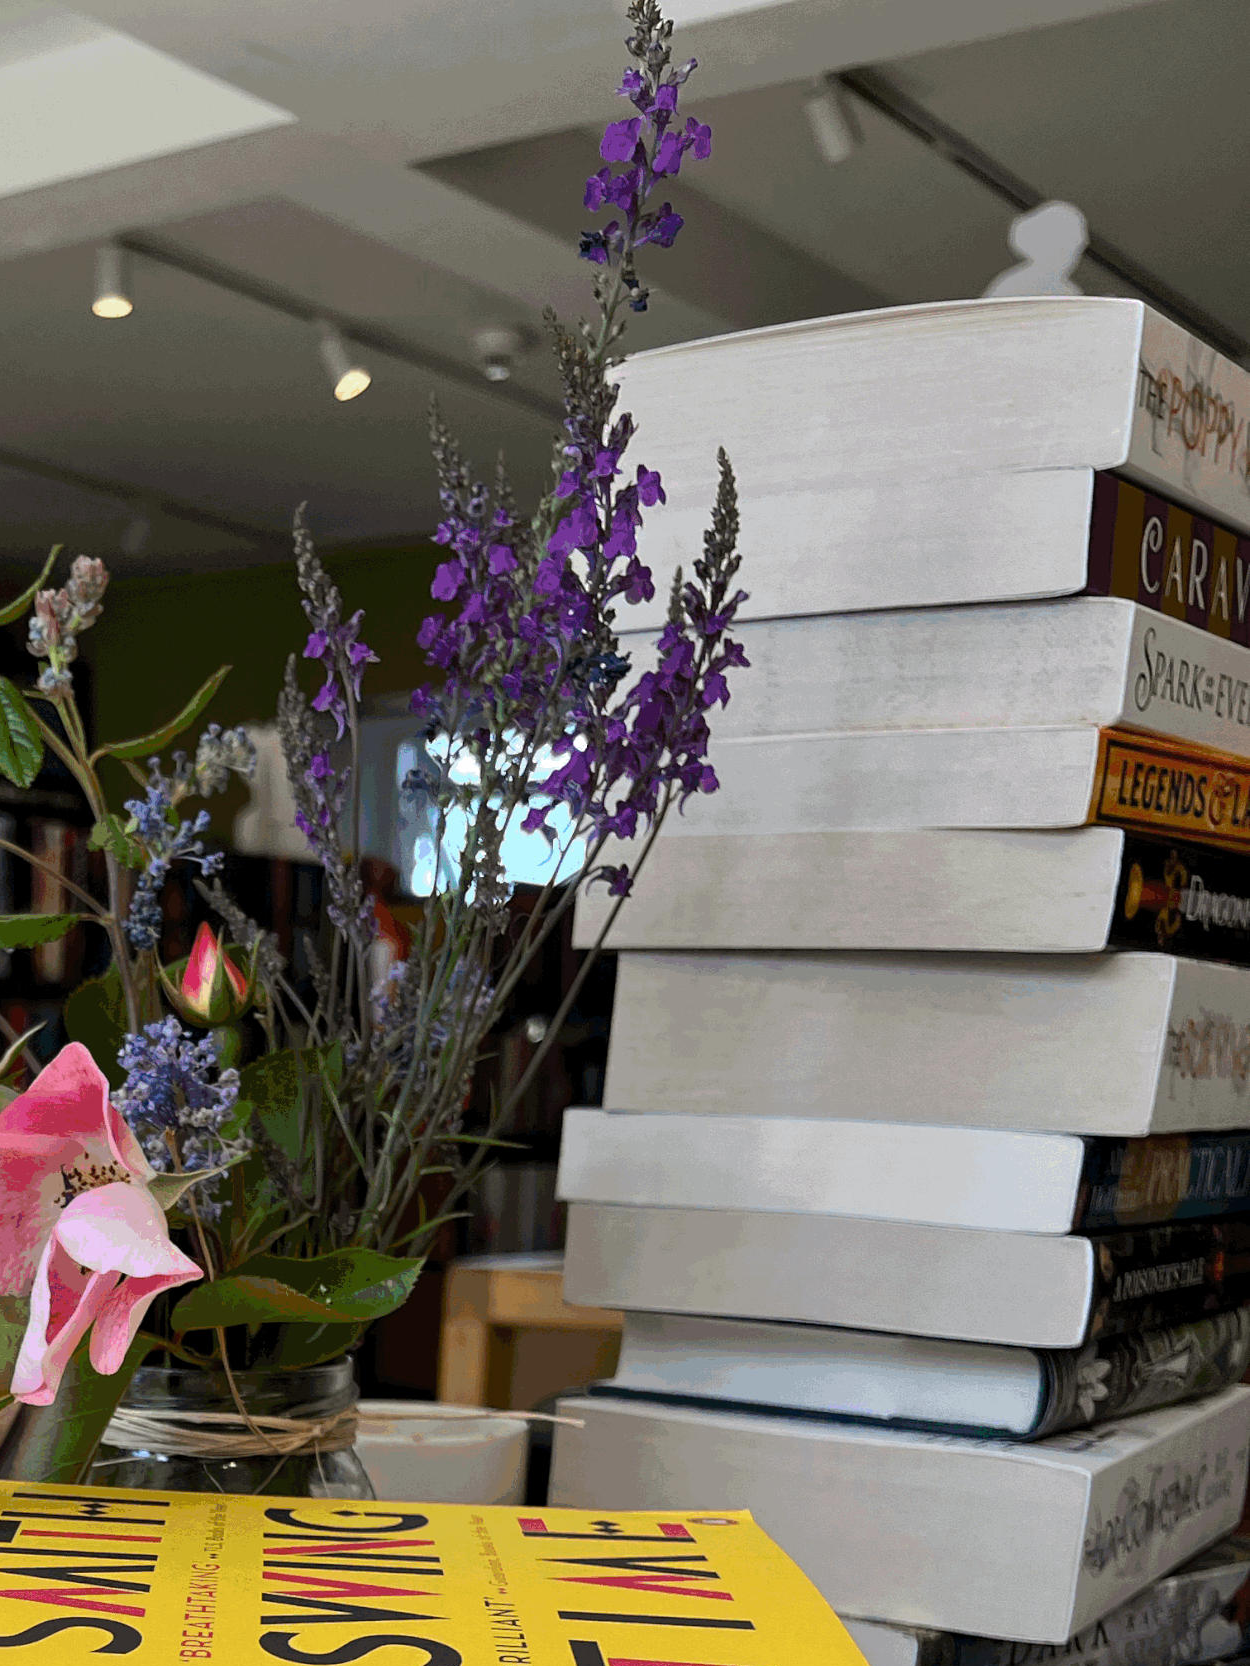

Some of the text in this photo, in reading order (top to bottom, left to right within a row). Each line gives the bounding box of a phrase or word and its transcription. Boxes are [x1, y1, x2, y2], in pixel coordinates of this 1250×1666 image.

[1141, 516, 1250, 624] CARAV
[1135, 627, 1203, 713] SPARK
[1215, 672, 1250, 727] EVE
[1118, 759, 1208, 820] LEGENDS
